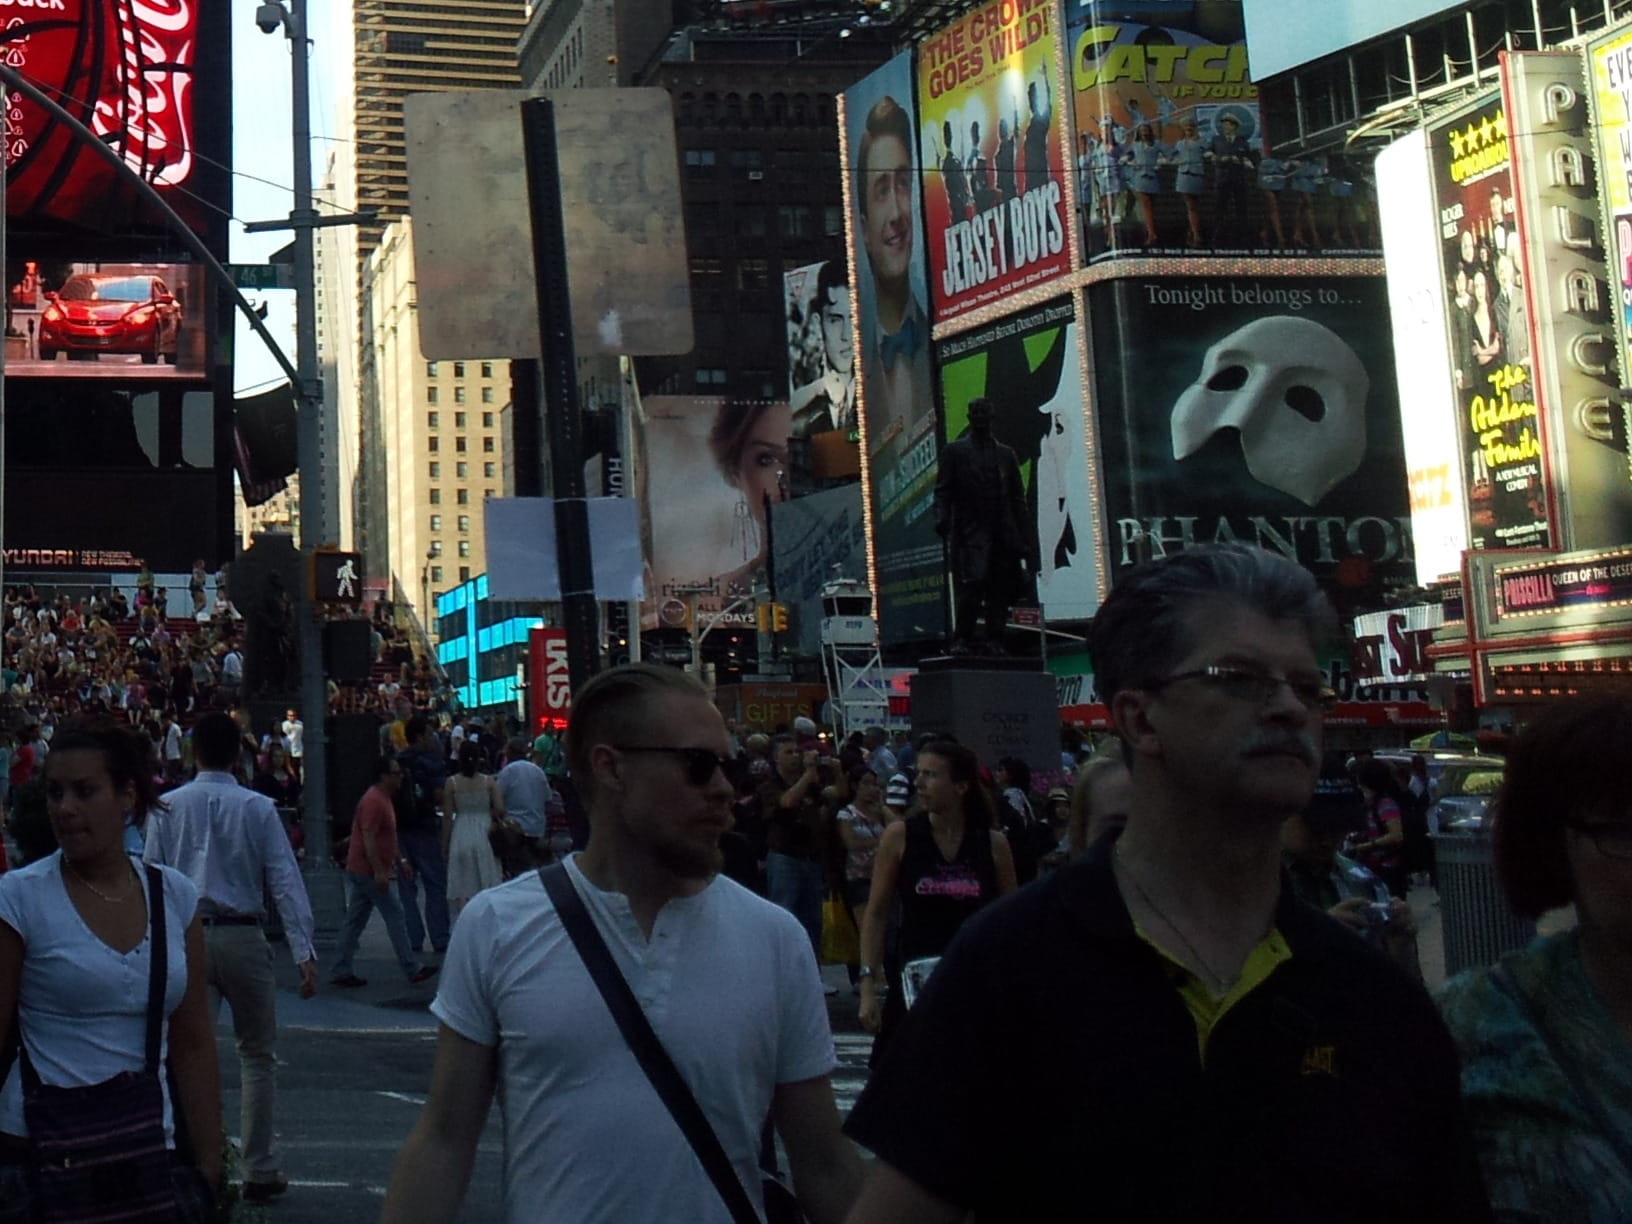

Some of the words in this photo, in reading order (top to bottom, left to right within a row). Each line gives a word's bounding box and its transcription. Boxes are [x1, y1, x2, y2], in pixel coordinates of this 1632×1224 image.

[929, 47, 984, 99] GOES
[1173, 85, 1193, 99] IF
[1200, 85, 1241, 99] YOU
[942, 203, 1008, 298] JERSEY
[1009, 180, 1064, 270] BOYS
[1543, 82, 1614, 440] PALACE
[1144, 283, 1227, 310] Tonight
[1231, 283, 1312, 310] belongs
[1488, 364, 1526, 396] The
[1552, 571, 1580, 586] QUEEN
[1580, 569, 1592, 583] OF
[1593, 566, 1609, 580] THE
[745, 703, 811, 723] GIFTS
